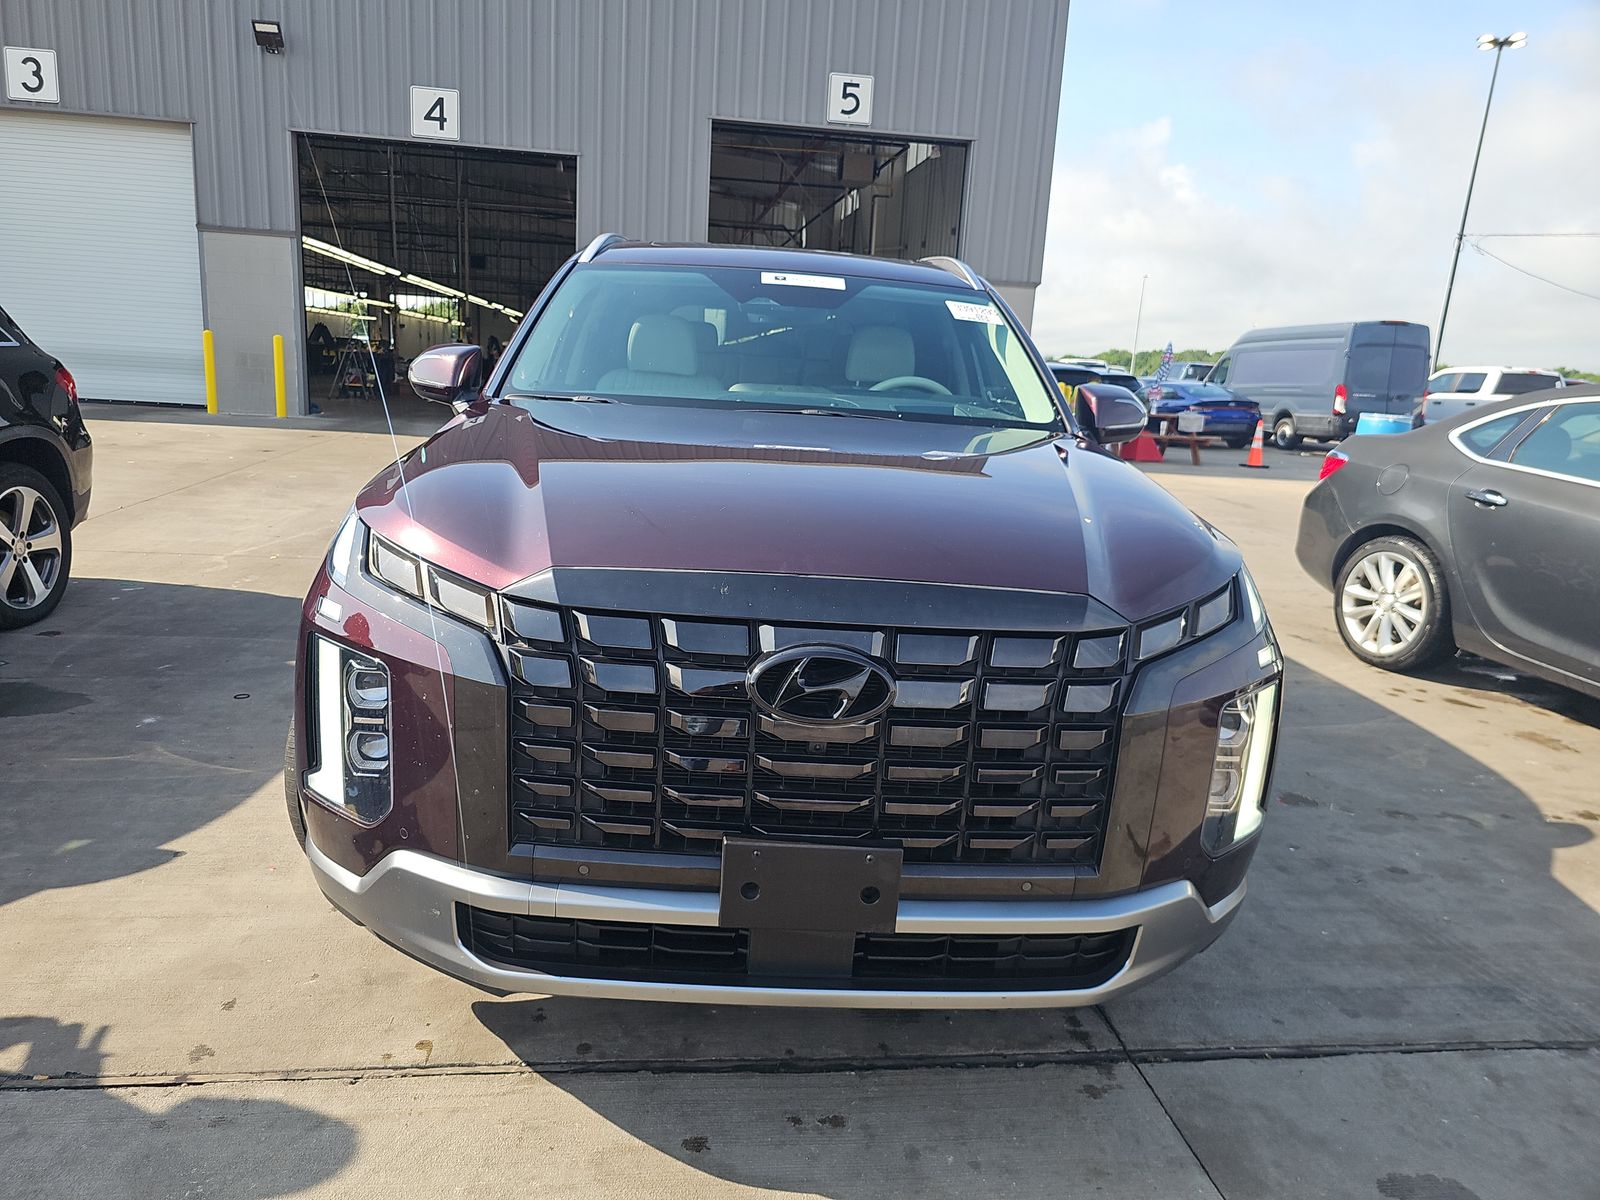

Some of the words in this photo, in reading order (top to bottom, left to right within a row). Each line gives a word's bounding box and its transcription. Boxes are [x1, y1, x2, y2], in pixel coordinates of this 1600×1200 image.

[21, 57, 44, 93] 3
[424, 97, 448, 131] 4
[840, 83, 860, 115] 5
